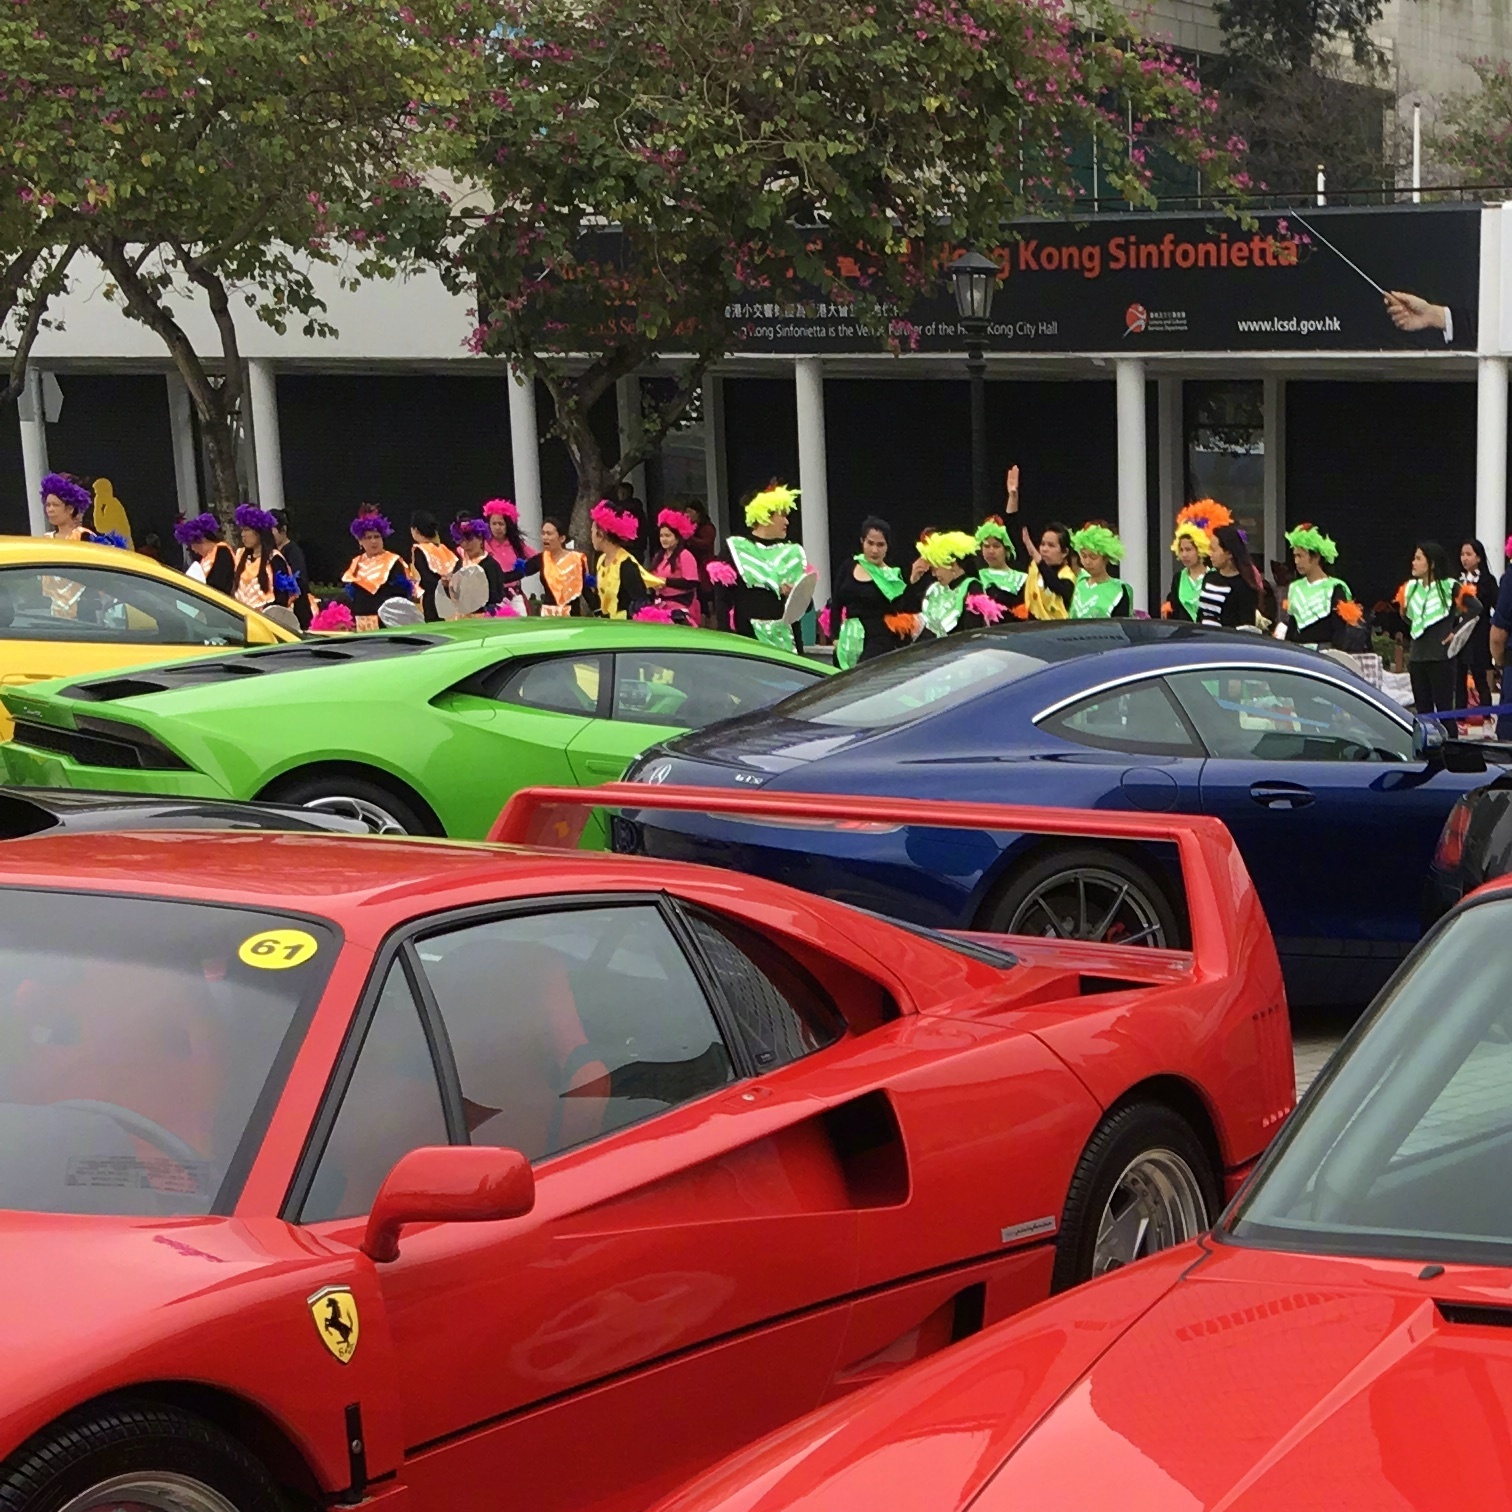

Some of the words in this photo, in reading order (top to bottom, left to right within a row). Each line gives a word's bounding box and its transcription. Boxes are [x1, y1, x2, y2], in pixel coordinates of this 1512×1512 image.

[1019, 239, 1101, 279] Kong
[1108, 233, 1298, 270] Sinfonietta
[838, 323, 854, 337] the
[925, 321, 936, 336] of
[938, 322, 955, 336] the
[1016, 321, 1036, 338] City
[1038, 320, 1058, 335] Hall
[1237, 316, 1342, 335] www.lcsd.gov.hk
[250, 939, 305, 961] 61
